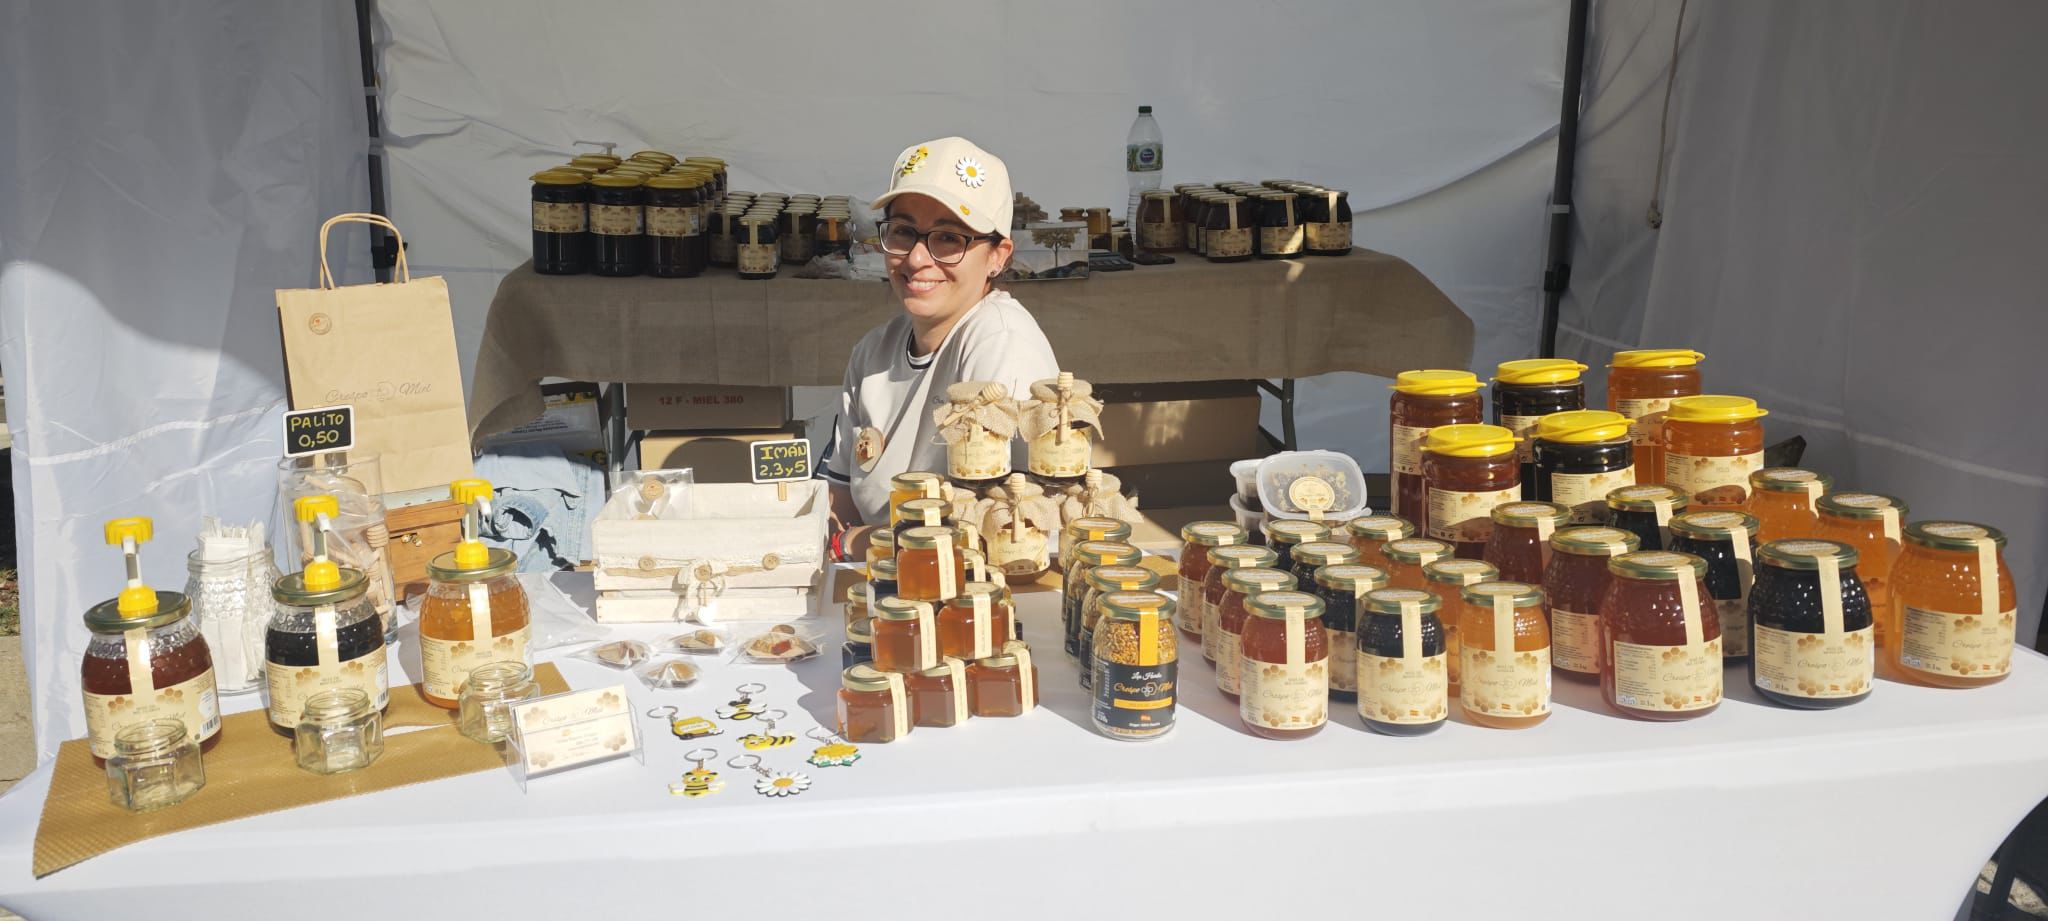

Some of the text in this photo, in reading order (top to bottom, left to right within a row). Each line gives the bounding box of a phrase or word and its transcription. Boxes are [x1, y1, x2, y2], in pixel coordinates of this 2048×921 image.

[399, 382, 432, 396] Miel
[659, 397, 673, 406] 12
[676, 396, 683, 405] F
[693, 396, 721, 405] MIEL
[299, 429, 339, 448] 0,50
[760, 443, 807, 460] IMÁN
[1797, 659, 1827, 669] Crespo
[1113, 682, 1140, 695] Crespo
[1262, 689, 1289, 702] Crespo
